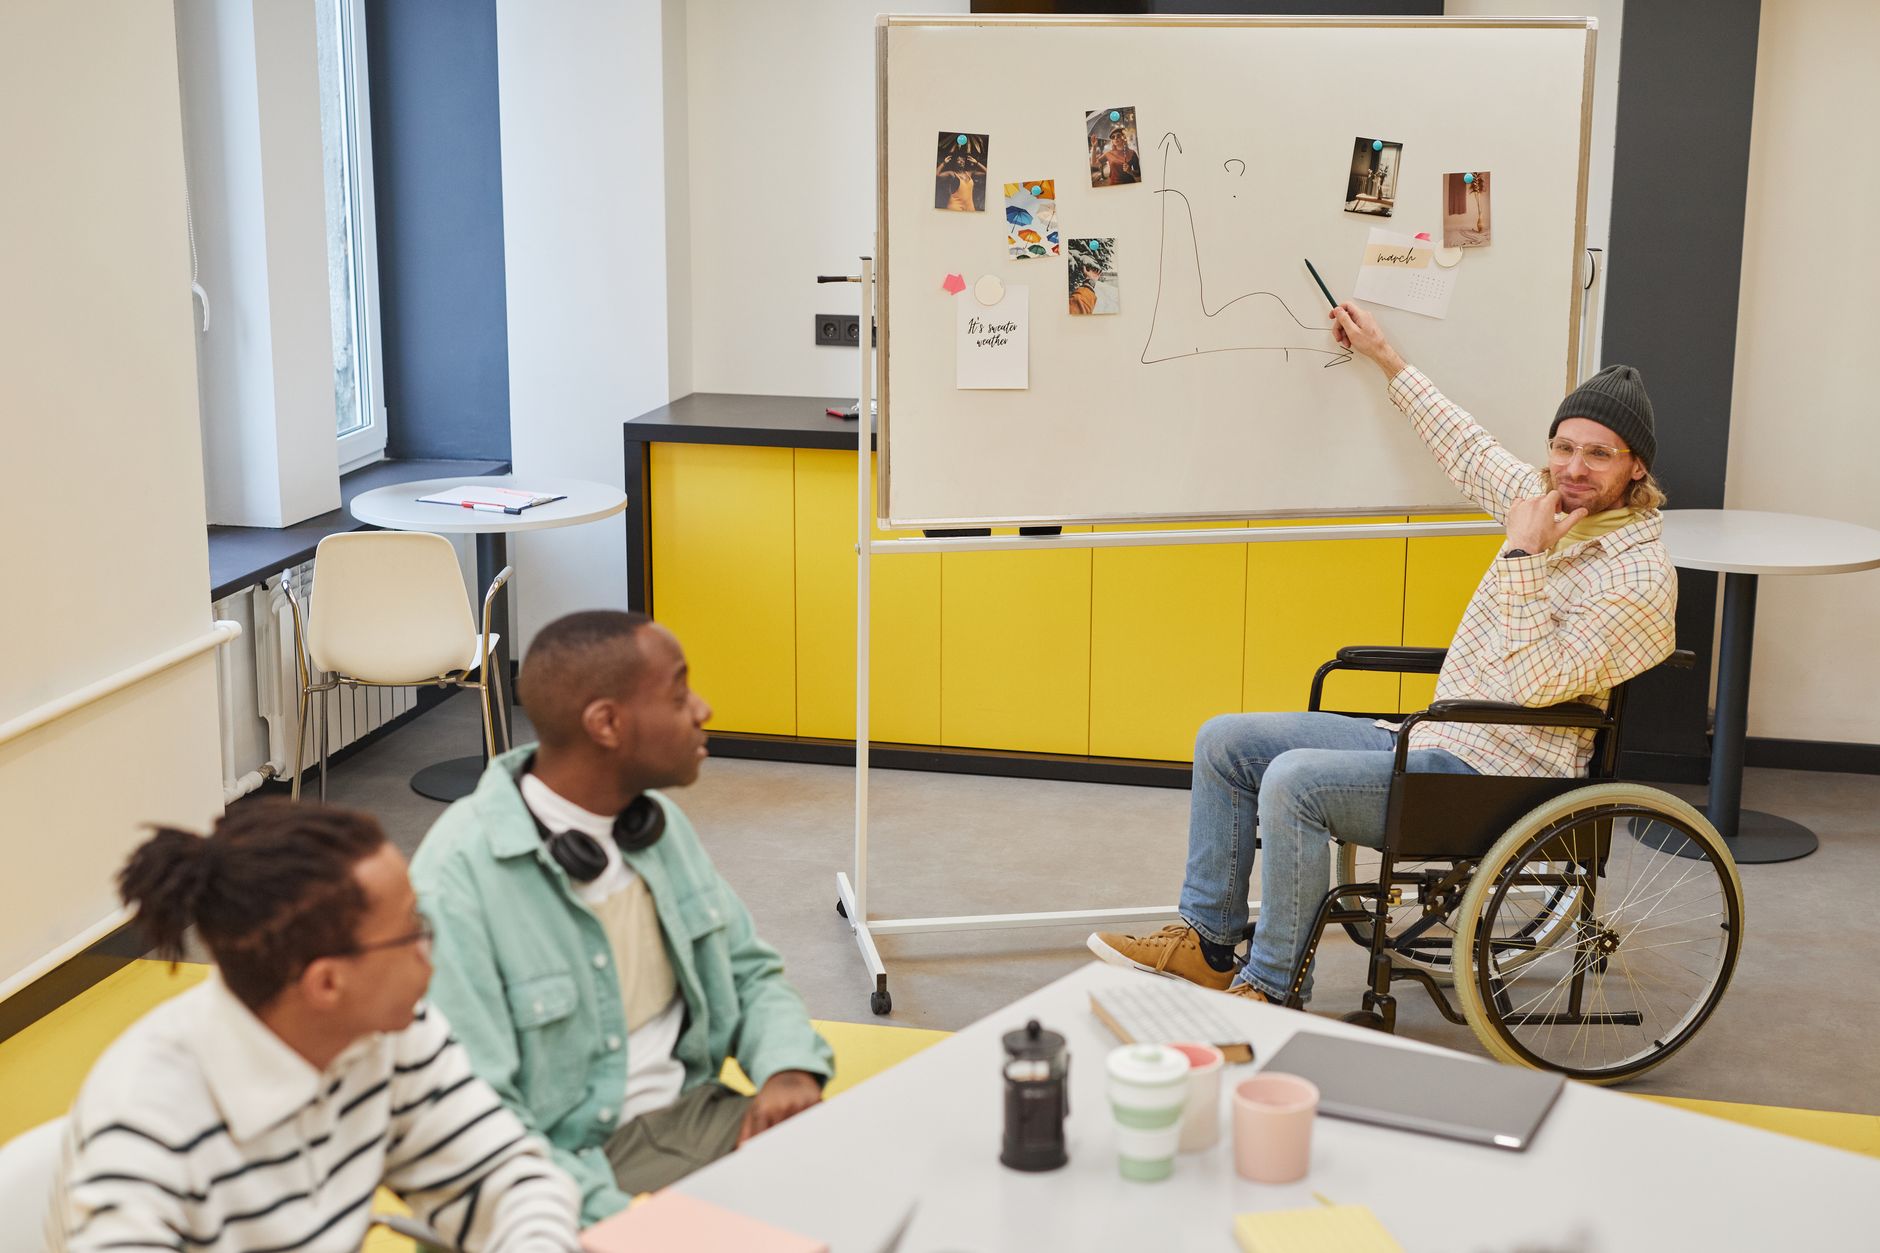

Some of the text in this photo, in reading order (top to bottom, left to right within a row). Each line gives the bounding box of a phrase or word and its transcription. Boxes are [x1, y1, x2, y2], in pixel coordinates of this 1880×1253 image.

[1377, 247, 1416, 264] march
[967, 316, 1018, 334] It's sweater
[976, 333, 1008, 348] weather
